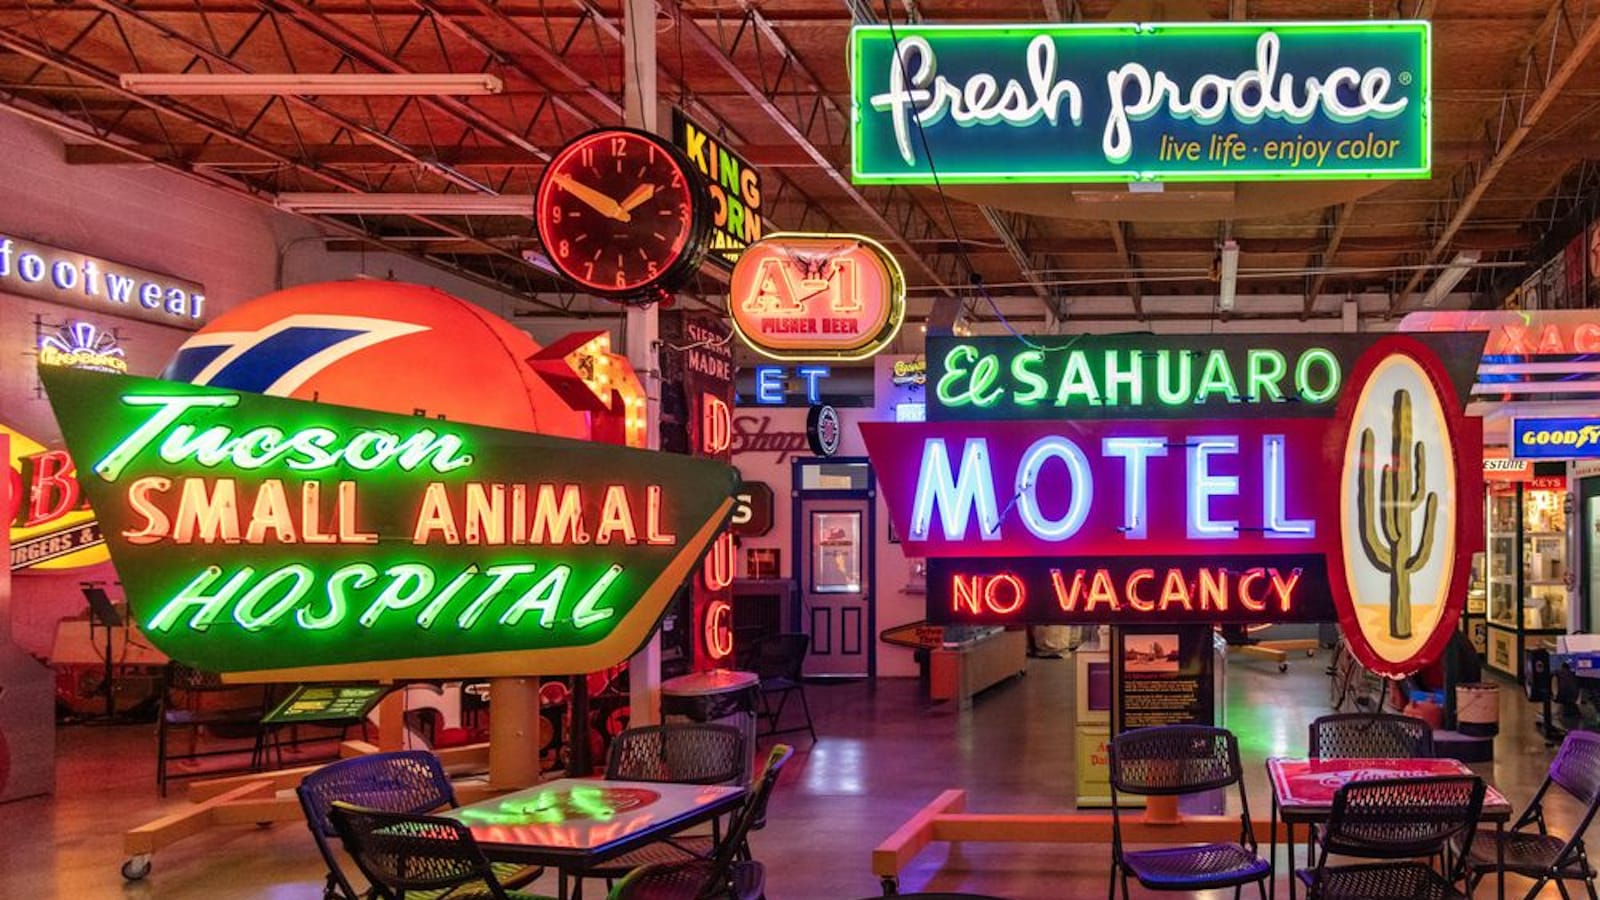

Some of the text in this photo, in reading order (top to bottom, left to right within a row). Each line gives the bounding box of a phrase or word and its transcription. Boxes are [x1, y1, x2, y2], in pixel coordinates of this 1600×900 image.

[870, 31, 1409, 166] fresh produce
[582, 148, 593, 167] 11
[611, 138, 626, 156] 12
[1159, 132, 1400, 166] live life enjoy color
[671, 170, 681, 188] 2
[685, 123, 761, 209] KING
[552, 206, 562, 224] 9
[710, 184, 762, 243] ORN
[559, 240, 569, 257] 8
[0, 236, 206, 320] footwear
[584, 262, 594, 281] 7
[616, 271, 626, 288] 6
[742, 257, 862, 313] A-1
[762, 318, 859, 334] PILSNER BEER
[688, 349, 730, 381] MADRE
[936, 344, 1342, 408] El SAHUARO
[92, 393, 475, 484] Tucson
[908, 434, 1317, 542] MOTEL
[1531, 479, 1561, 488] KEYS
[121, 475, 677, 547] SMALL ANIMAL
[11, 533, 73, 564] RGERS
[146, 560, 625, 634] HOSPITAL
[952, 566, 1305, 615] NO VACANCY
